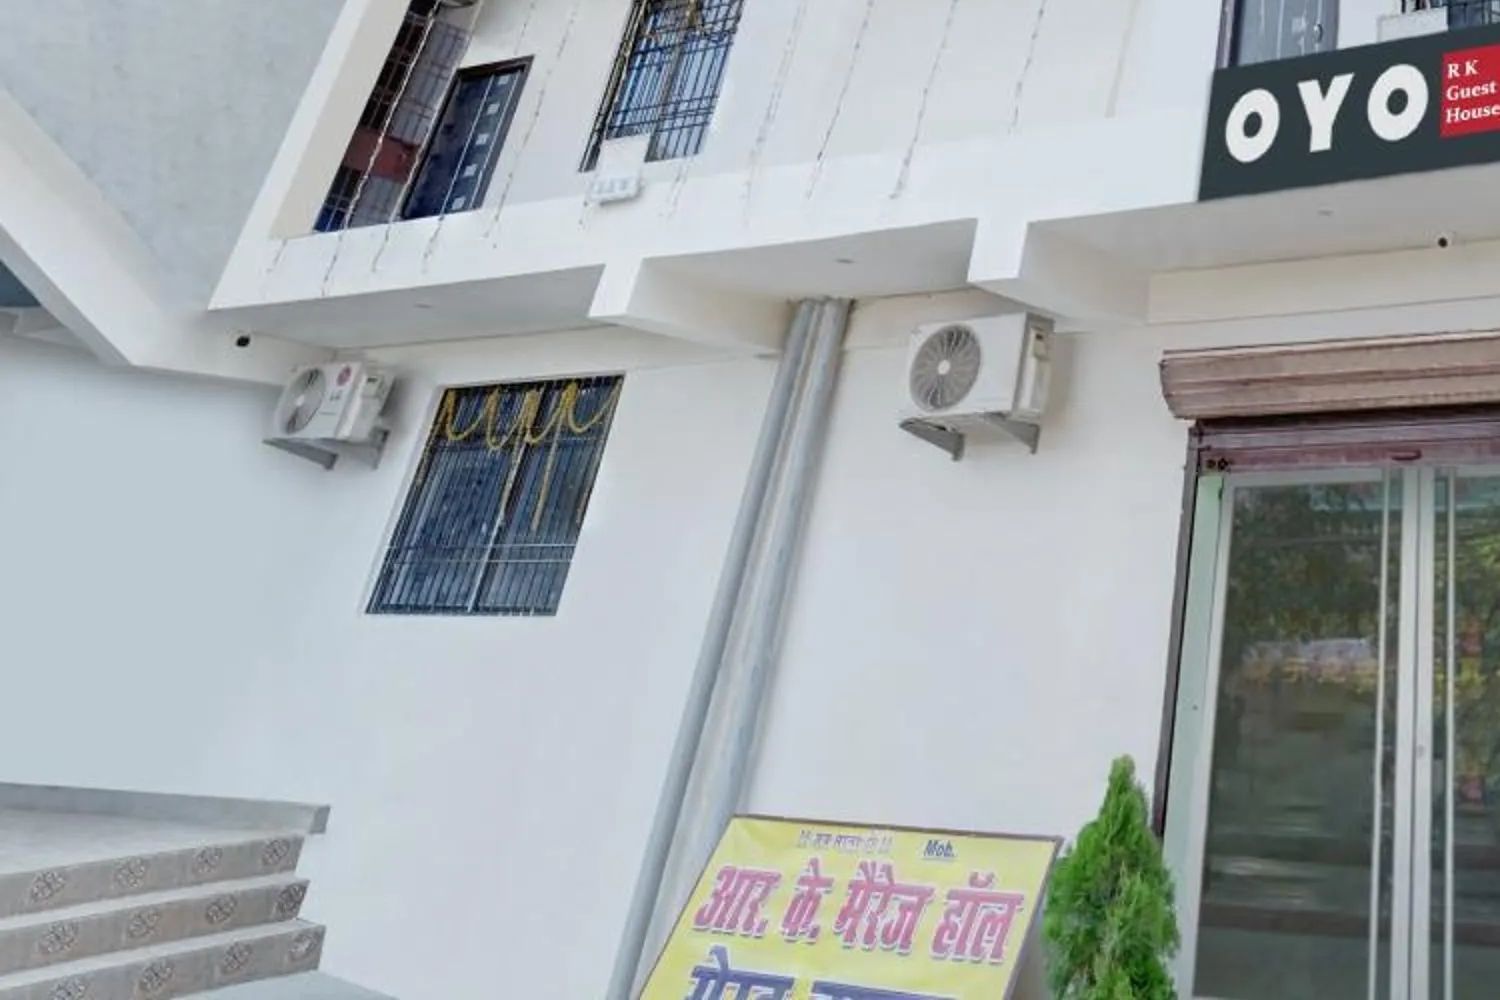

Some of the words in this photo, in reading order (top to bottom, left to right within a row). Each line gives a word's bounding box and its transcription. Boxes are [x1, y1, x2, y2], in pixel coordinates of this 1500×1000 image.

[1447, 61, 1460, 79] R
[1464, 59, 1479, 76] K
[1447, 81, 1498, 102] Guest
[1225, 63, 1429, 164] OYO
[924, 839, 956, 858] Mob.
[692, 865, 781, 939] आर.
[782, 857, 834, 943] के.
[832, 860, 935, 955] मैरेज
[932, 871, 1025, 966] हॉल
